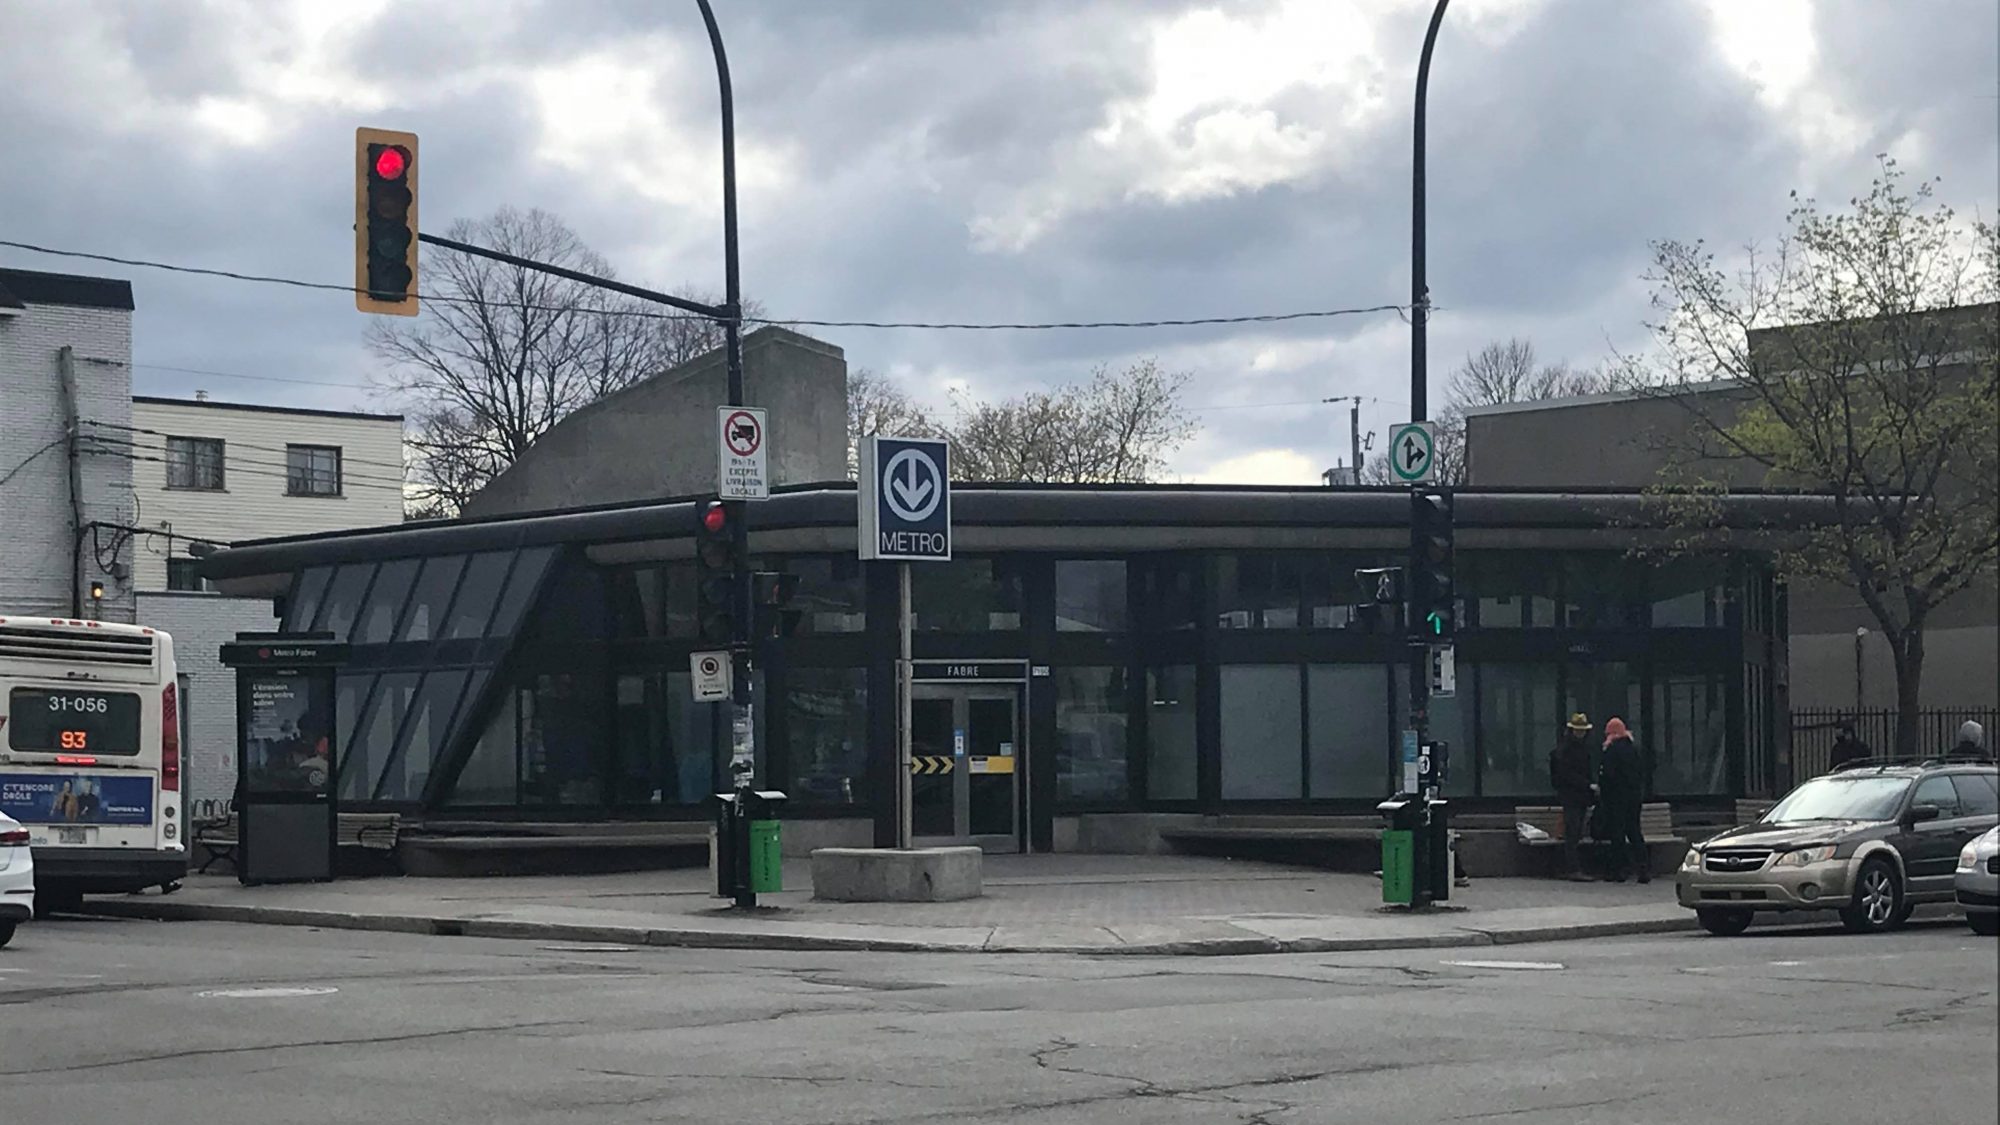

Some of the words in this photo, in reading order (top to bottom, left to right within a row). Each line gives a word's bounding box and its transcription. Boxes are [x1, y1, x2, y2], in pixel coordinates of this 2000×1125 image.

[725, 478, 763, 486] LIVRAISON
[730, 487, 757, 496] LOCALE
[881, 531, 946, 553] METRO
[947, 665, 979, 677] FABRE
[49, 696, 108, 713] 31-056
[61, 731, 87, 749] 93
